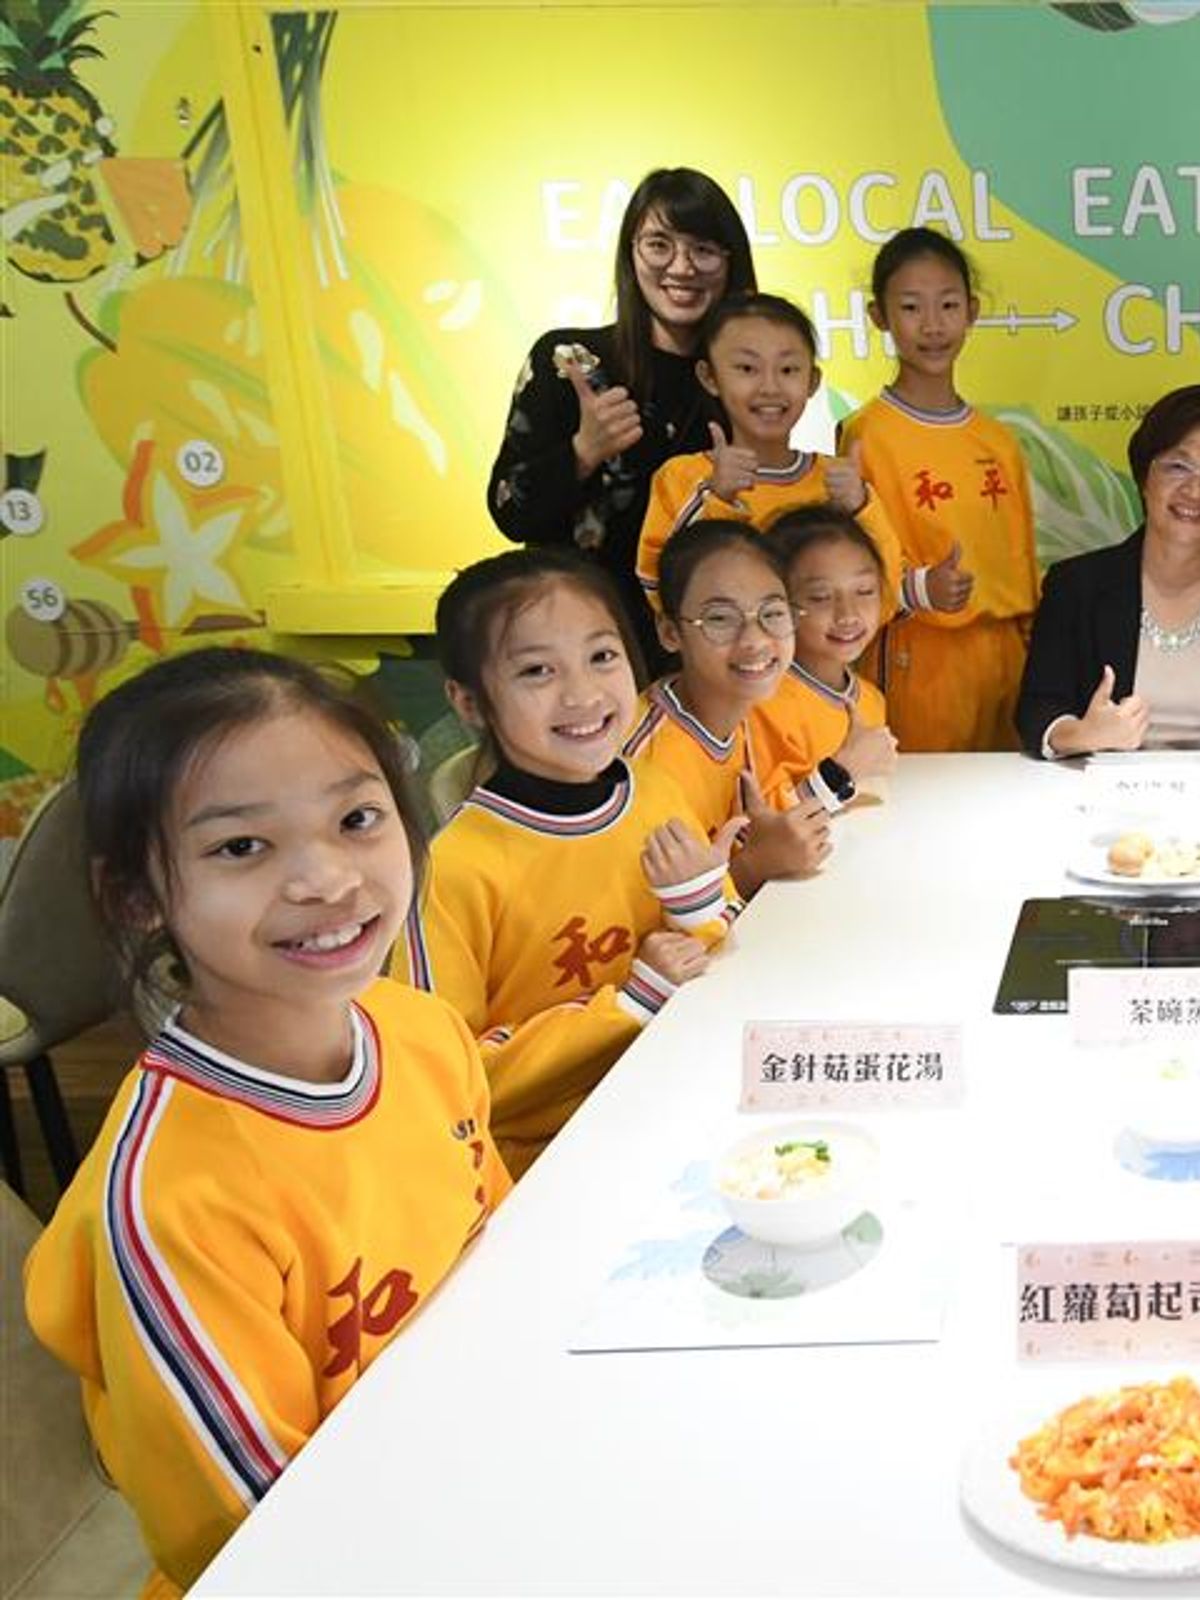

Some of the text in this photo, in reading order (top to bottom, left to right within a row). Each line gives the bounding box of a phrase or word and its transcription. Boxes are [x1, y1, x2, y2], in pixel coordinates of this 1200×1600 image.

[184, 451, 219, 474] 02
[7, 500, 31, 521] 13
[27, 587, 58, 609] 56
[553, 916, 632, 988] 和
[760, 1051, 945, 1084] 金針菇蛋花湯
[321, 1255, 420, 1381] 和
